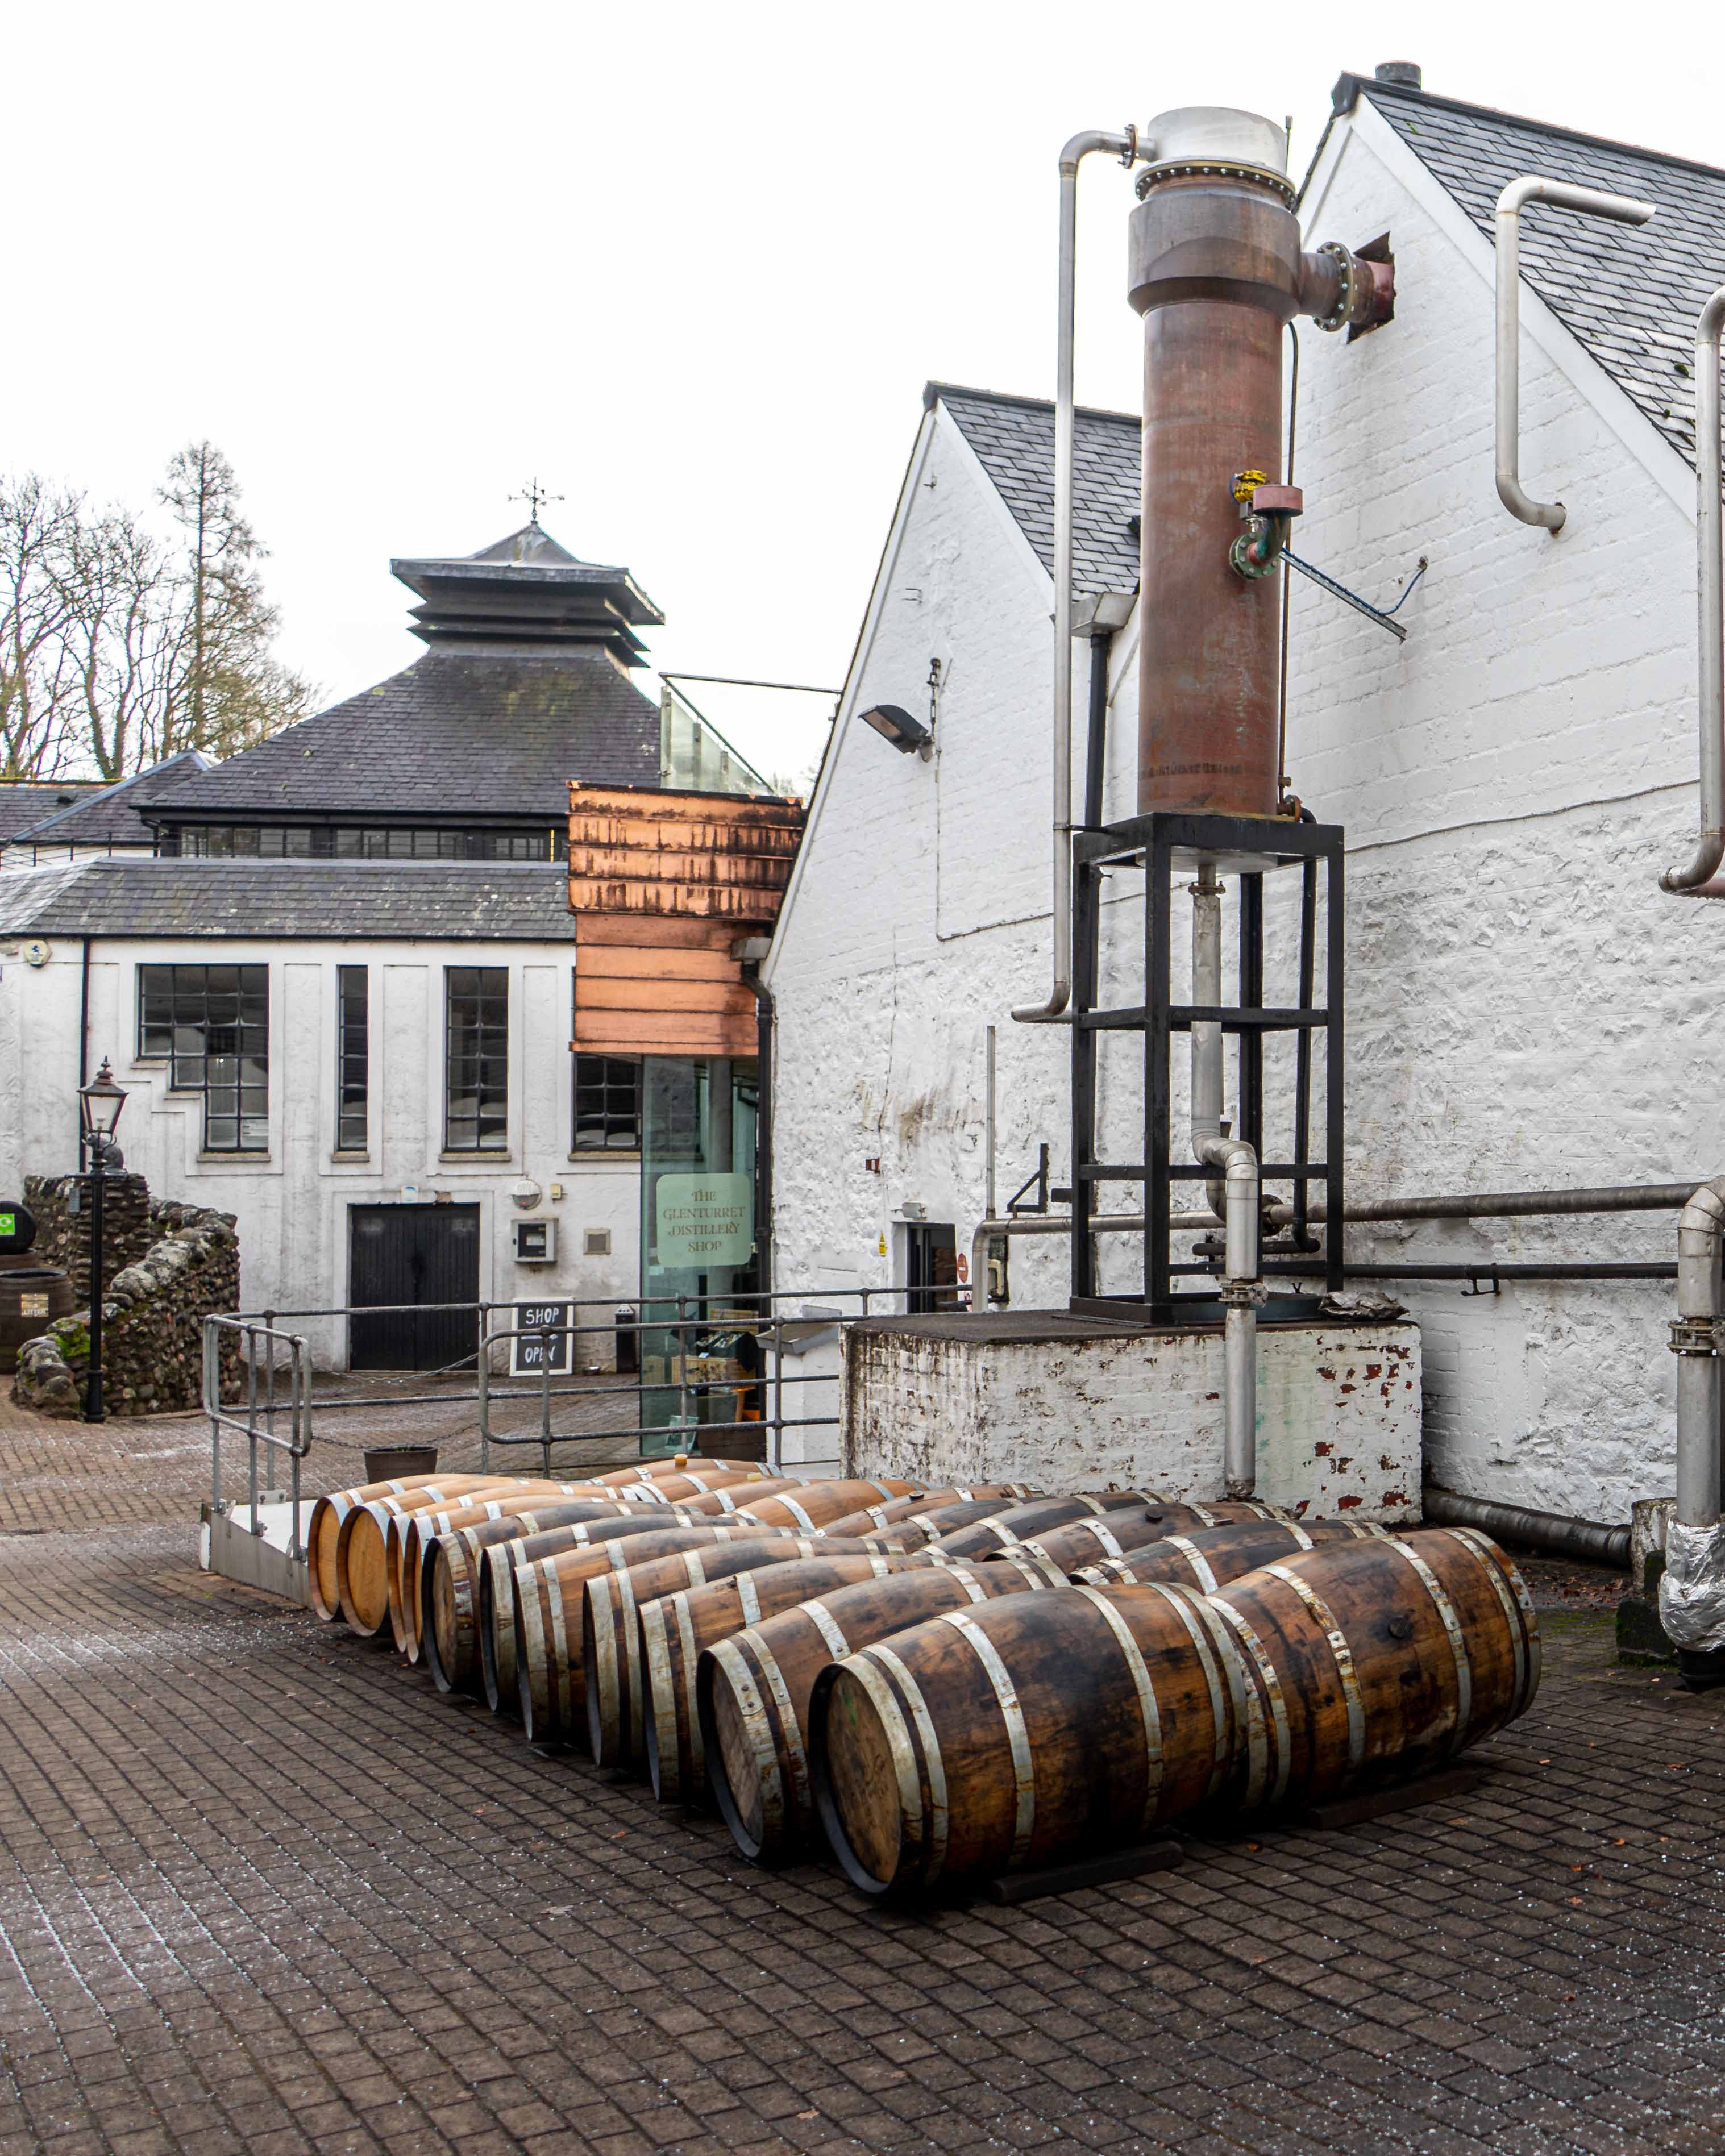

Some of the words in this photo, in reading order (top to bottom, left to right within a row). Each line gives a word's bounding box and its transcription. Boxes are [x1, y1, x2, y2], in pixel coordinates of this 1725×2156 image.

[692, 1189, 716, 1202] THE
[663, 1207, 745, 1221] GLENTURRET
[668, 1222, 741, 1237] DISTILLERY
[688, 1241, 722, 1252] SHOP
[526, 1308, 559, 1325] SHOP
